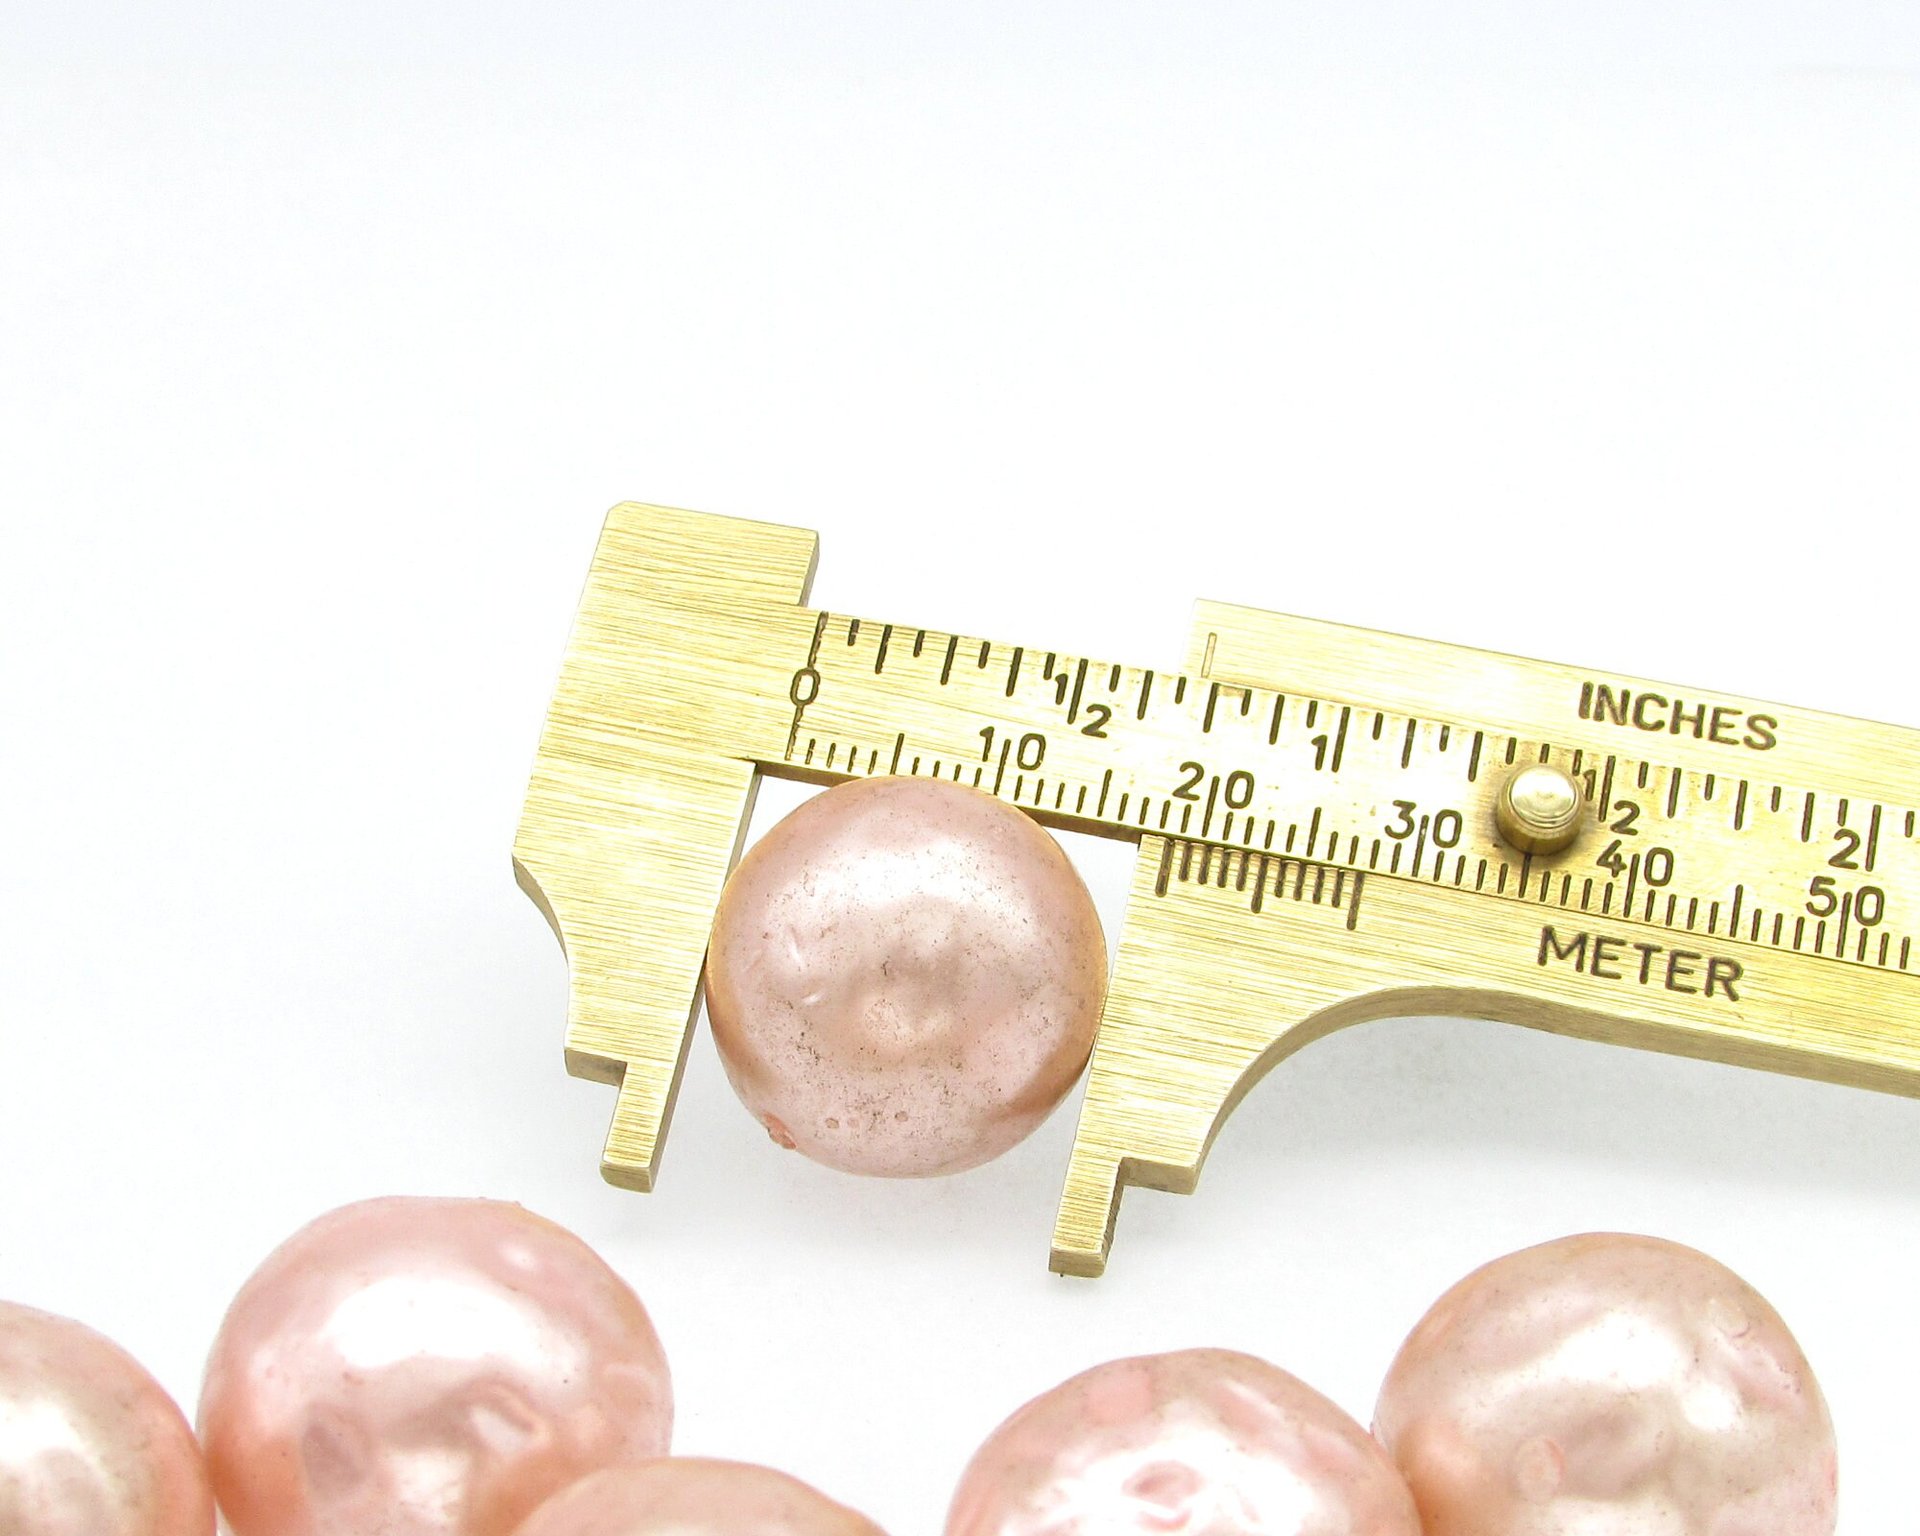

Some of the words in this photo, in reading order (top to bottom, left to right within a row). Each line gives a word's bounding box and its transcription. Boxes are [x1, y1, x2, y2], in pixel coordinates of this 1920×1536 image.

[789, 667, 820, 707] 0
[1578, 681, 1778, 752] INCHES
[1828, 828, 1861, 870] 2
[1536, 925, 1744, 1002] METER
